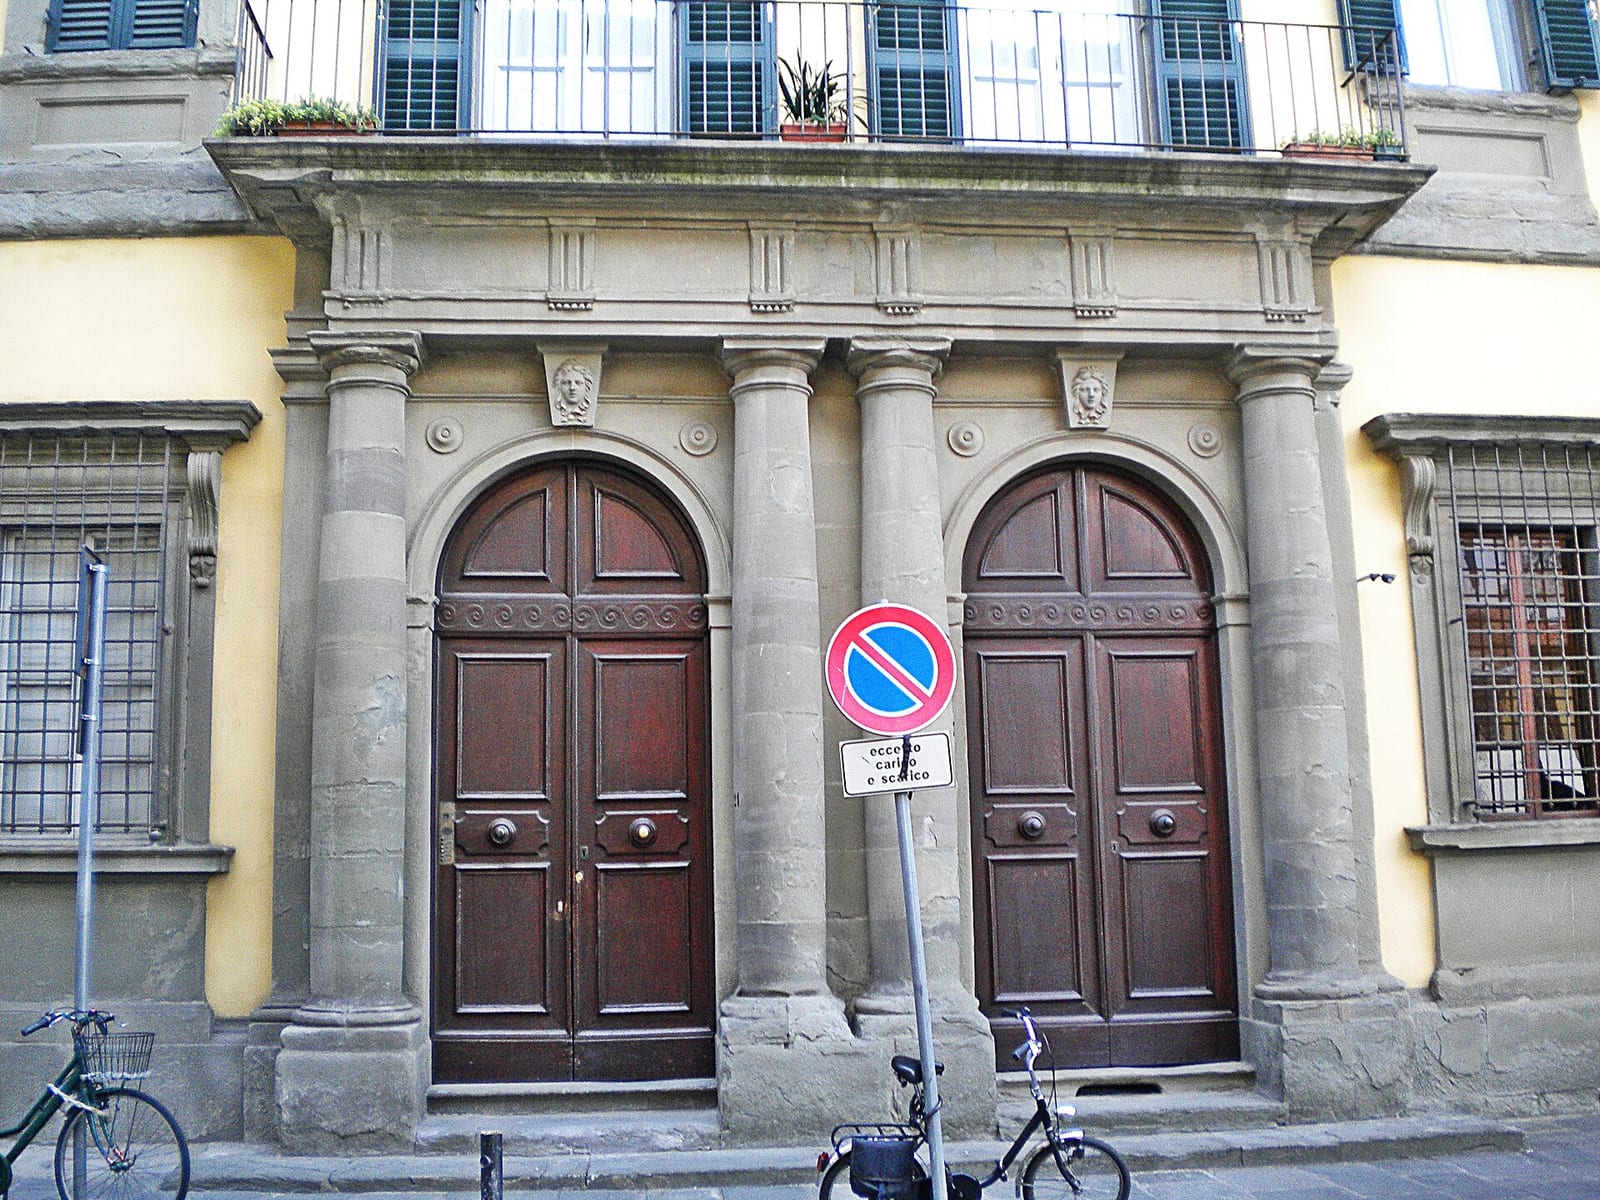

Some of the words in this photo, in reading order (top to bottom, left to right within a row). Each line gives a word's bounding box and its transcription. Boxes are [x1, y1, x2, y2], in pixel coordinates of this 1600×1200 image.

[870, 743, 921, 757] ecceto
[876, 757, 917, 770] cario
[867, 777, 875, 785] e
